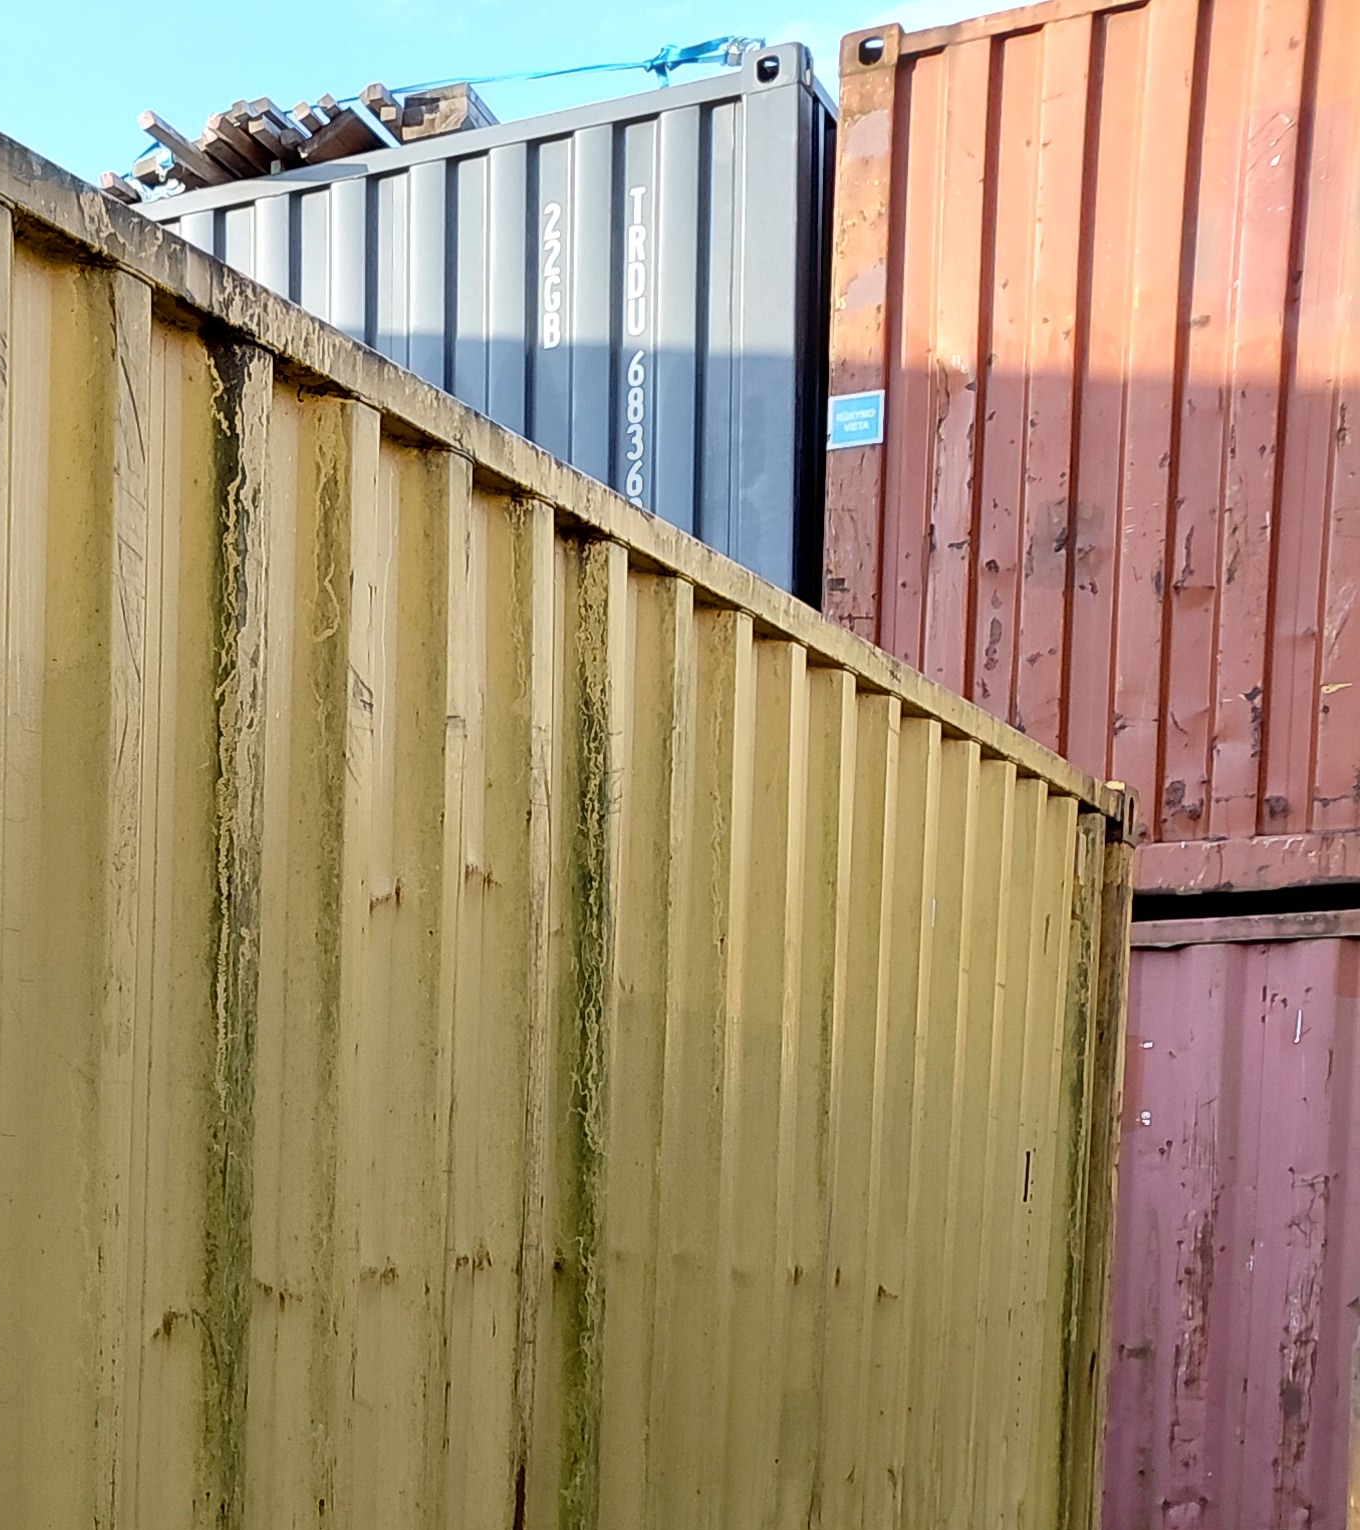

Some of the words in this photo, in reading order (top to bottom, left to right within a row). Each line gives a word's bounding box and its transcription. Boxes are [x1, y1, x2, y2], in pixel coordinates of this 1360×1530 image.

[542, 202, 562, 349] 22GB
[626, 186, 647, 337] TRDU
[625, 350, 645, 508] 6836
